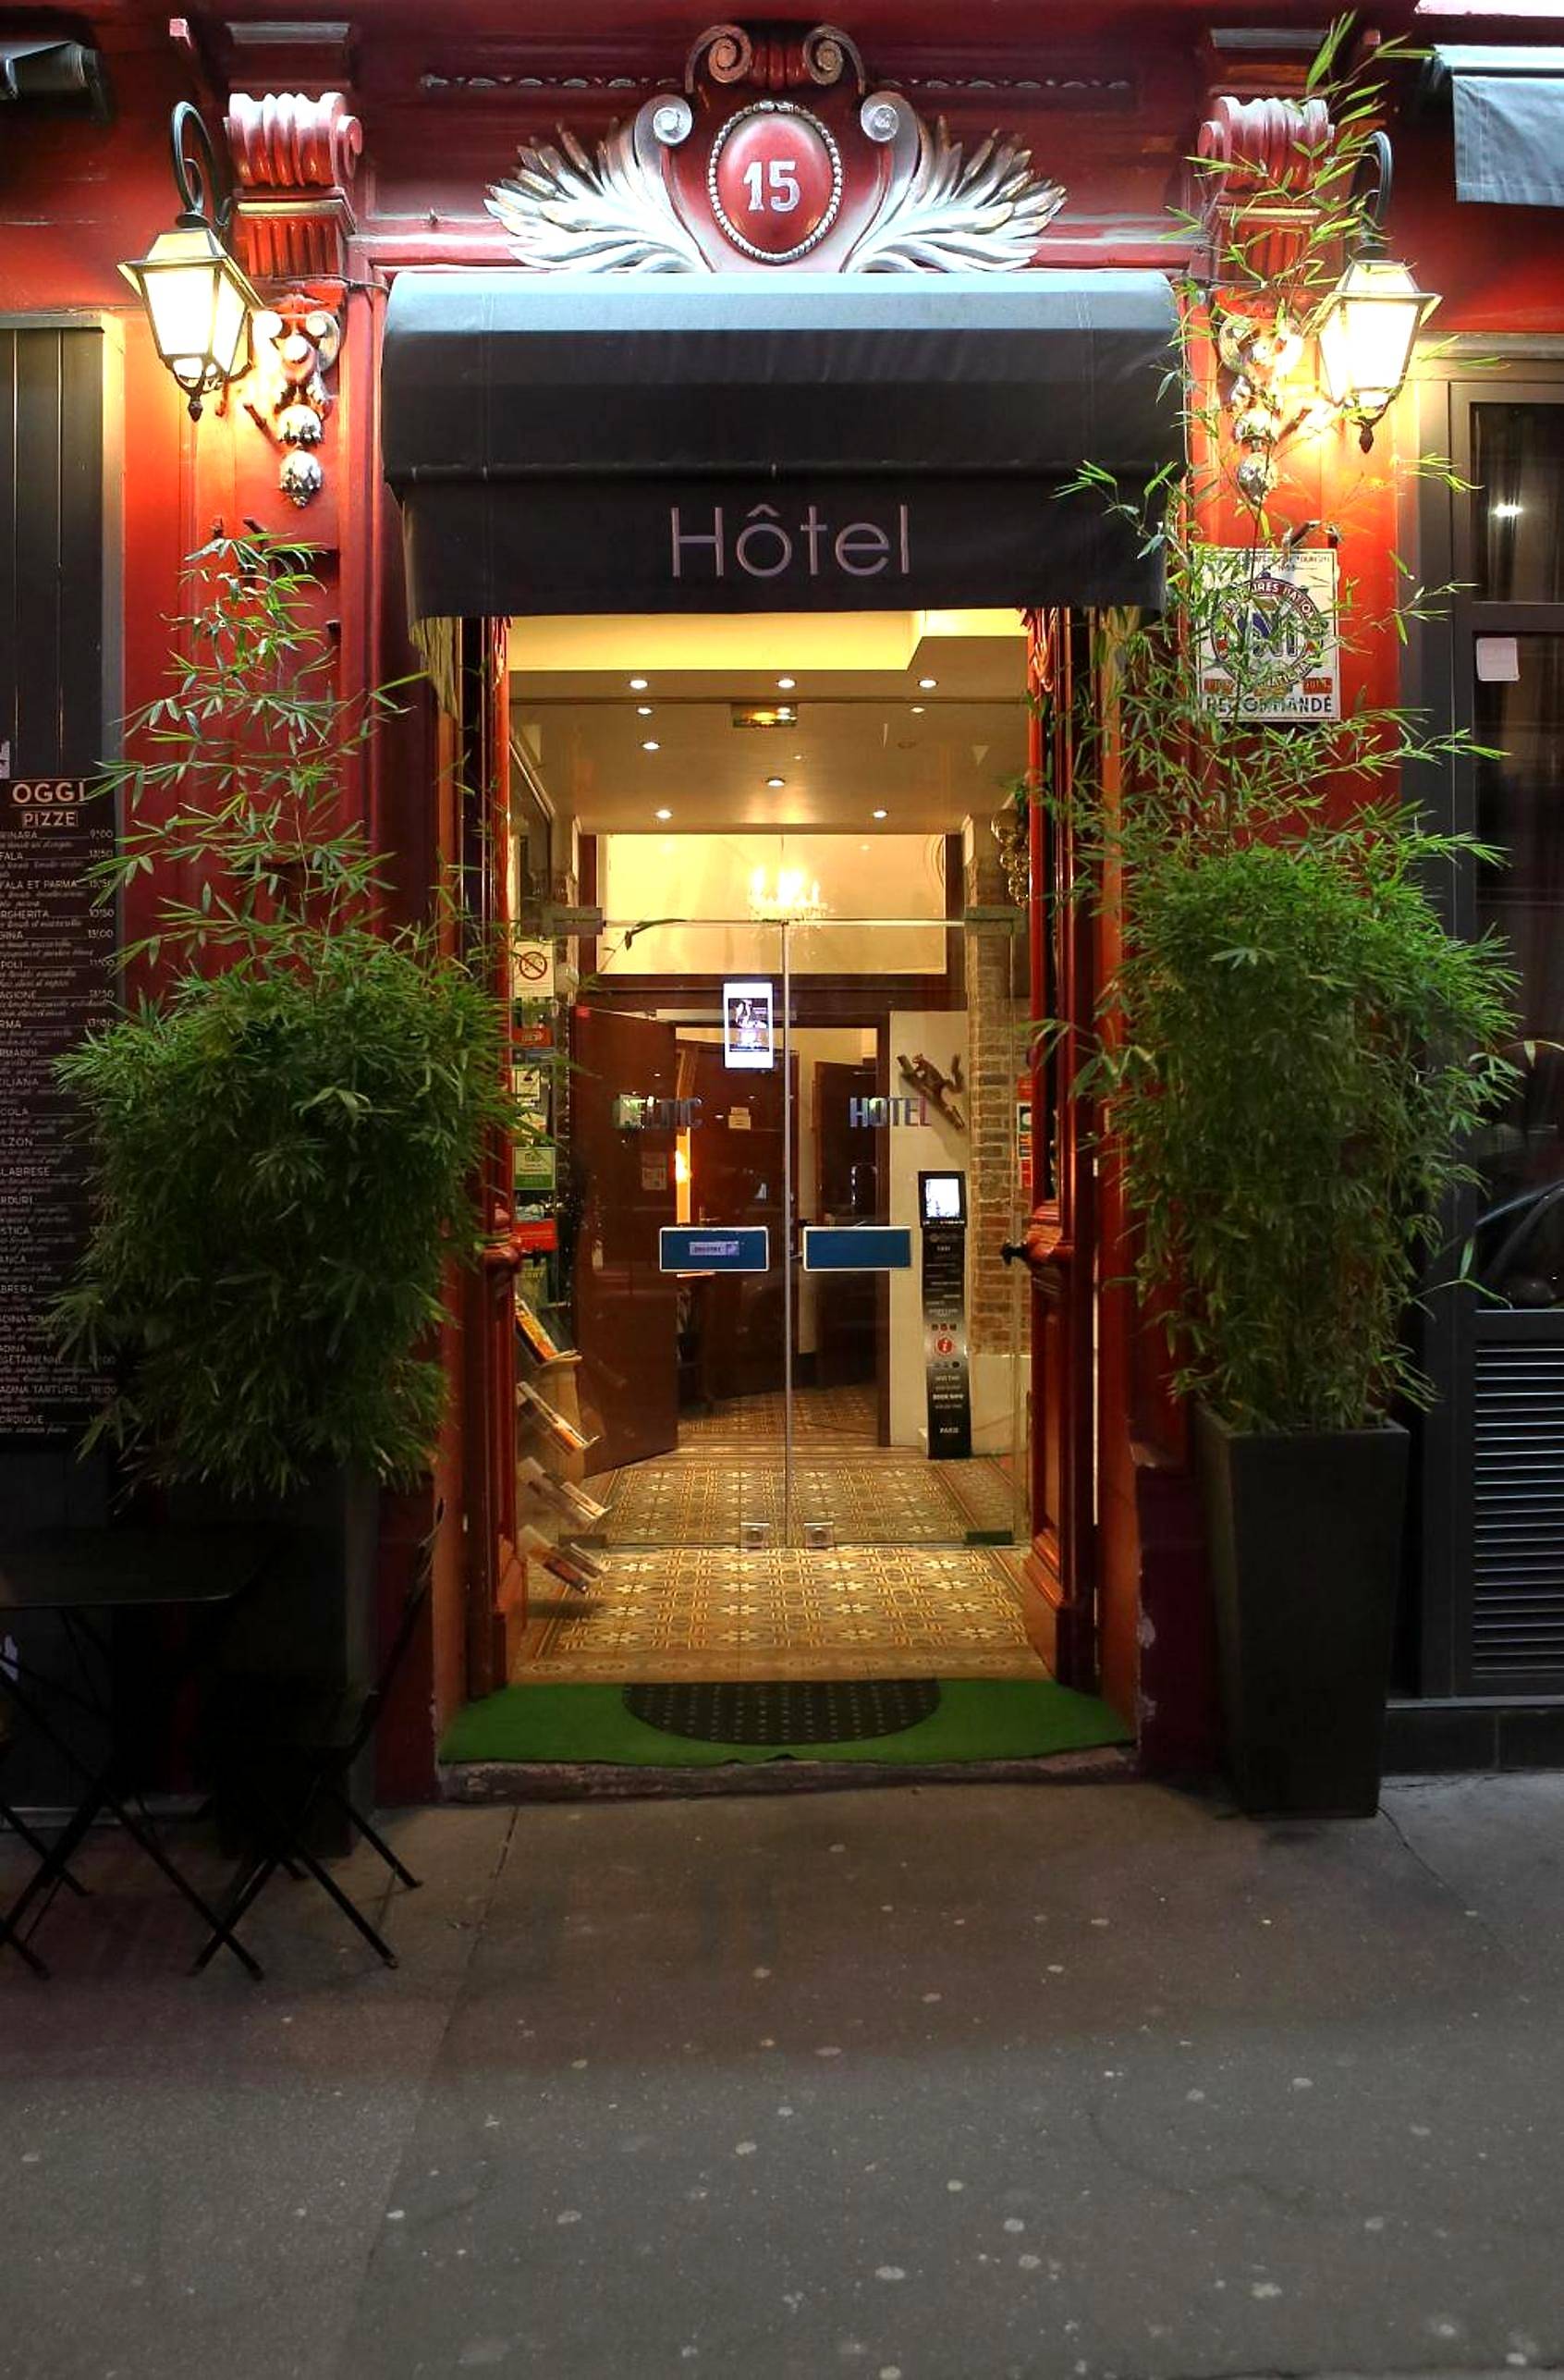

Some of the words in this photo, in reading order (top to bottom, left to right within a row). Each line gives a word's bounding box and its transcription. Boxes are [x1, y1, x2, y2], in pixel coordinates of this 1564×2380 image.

[743, 160, 800, 212] 15
[671, 504, 910, 577] Hôtel
[12, 781, 85, 804] OGGI
[24, 812, 75, 826] PIZZE
[849, 1097, 932, 1128] HOTEL
